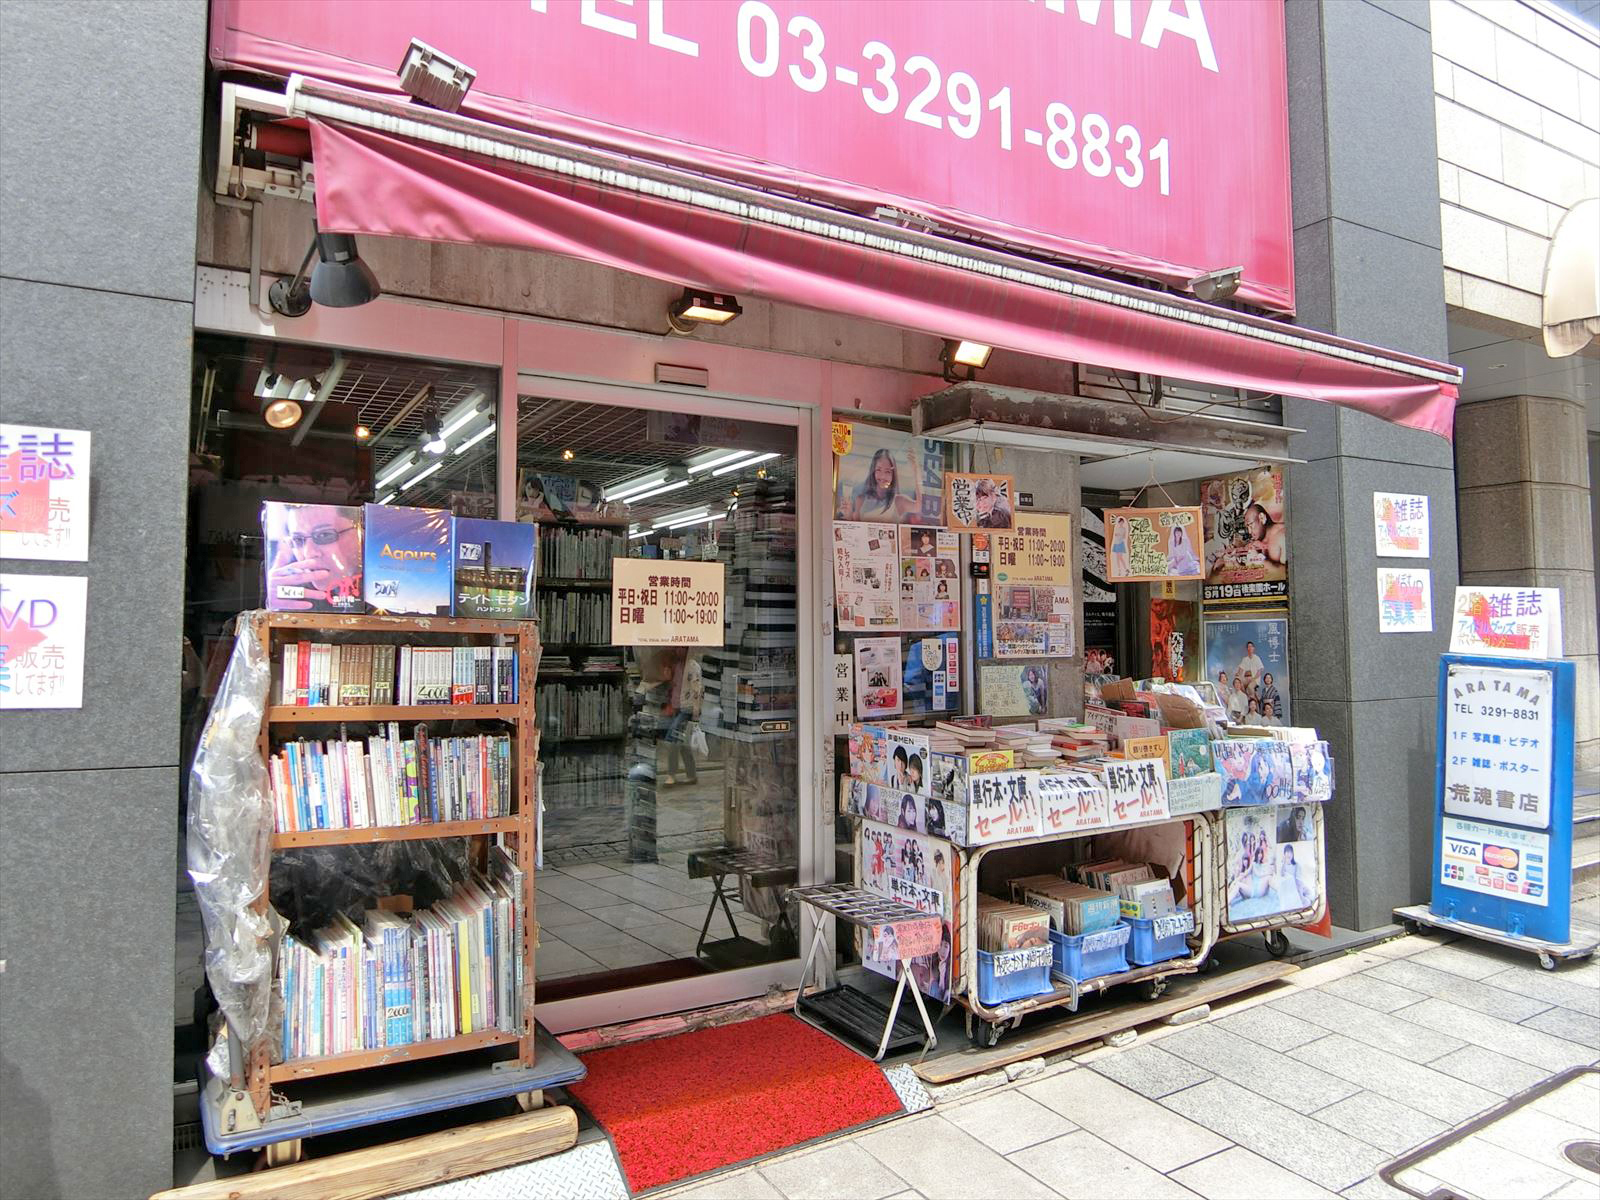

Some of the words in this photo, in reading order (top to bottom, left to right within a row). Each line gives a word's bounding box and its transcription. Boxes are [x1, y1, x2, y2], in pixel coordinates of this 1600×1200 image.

[737, 0, 1170, 196] 03-3291-8831
[952, 478, 974, 526] 営業中
[1394, 497, 1424, 522] 雑誌
[1017, 526, 1047, 538] 営業時間
[998, 537, 1025, 552] 平日・祝日
[999, 552, 1017, 566] 日曜
[648, 575, 692, 588] 営業時間
[618, 588, 658, 606] 平日・祝日
[1488, 590, 1542, 619] 雑誌
[620, 607, 645, 624] 日曜
[670, 635, 699, 643] ARATAMA
[1267, 622, 1281, 662] 風博士
[14, 645, 65, 670] 販売
[834, 662, 849, 726] 営業中
[1453, 679, 1540, 706] ARATAMA
[1454, 703, 1473, 715] TEL
[1481, 705, 1539, 721] 3291-8831
[1452, 783, 1539, 814] 荒魂書店
[1075, 817, 1102, 826] ARATAMA
[1139, 808, 1163, 817] ARATAMA
[1006, 825, 1035, 836] ARATAMA
[1450, 843, 1477, 857] VISA
